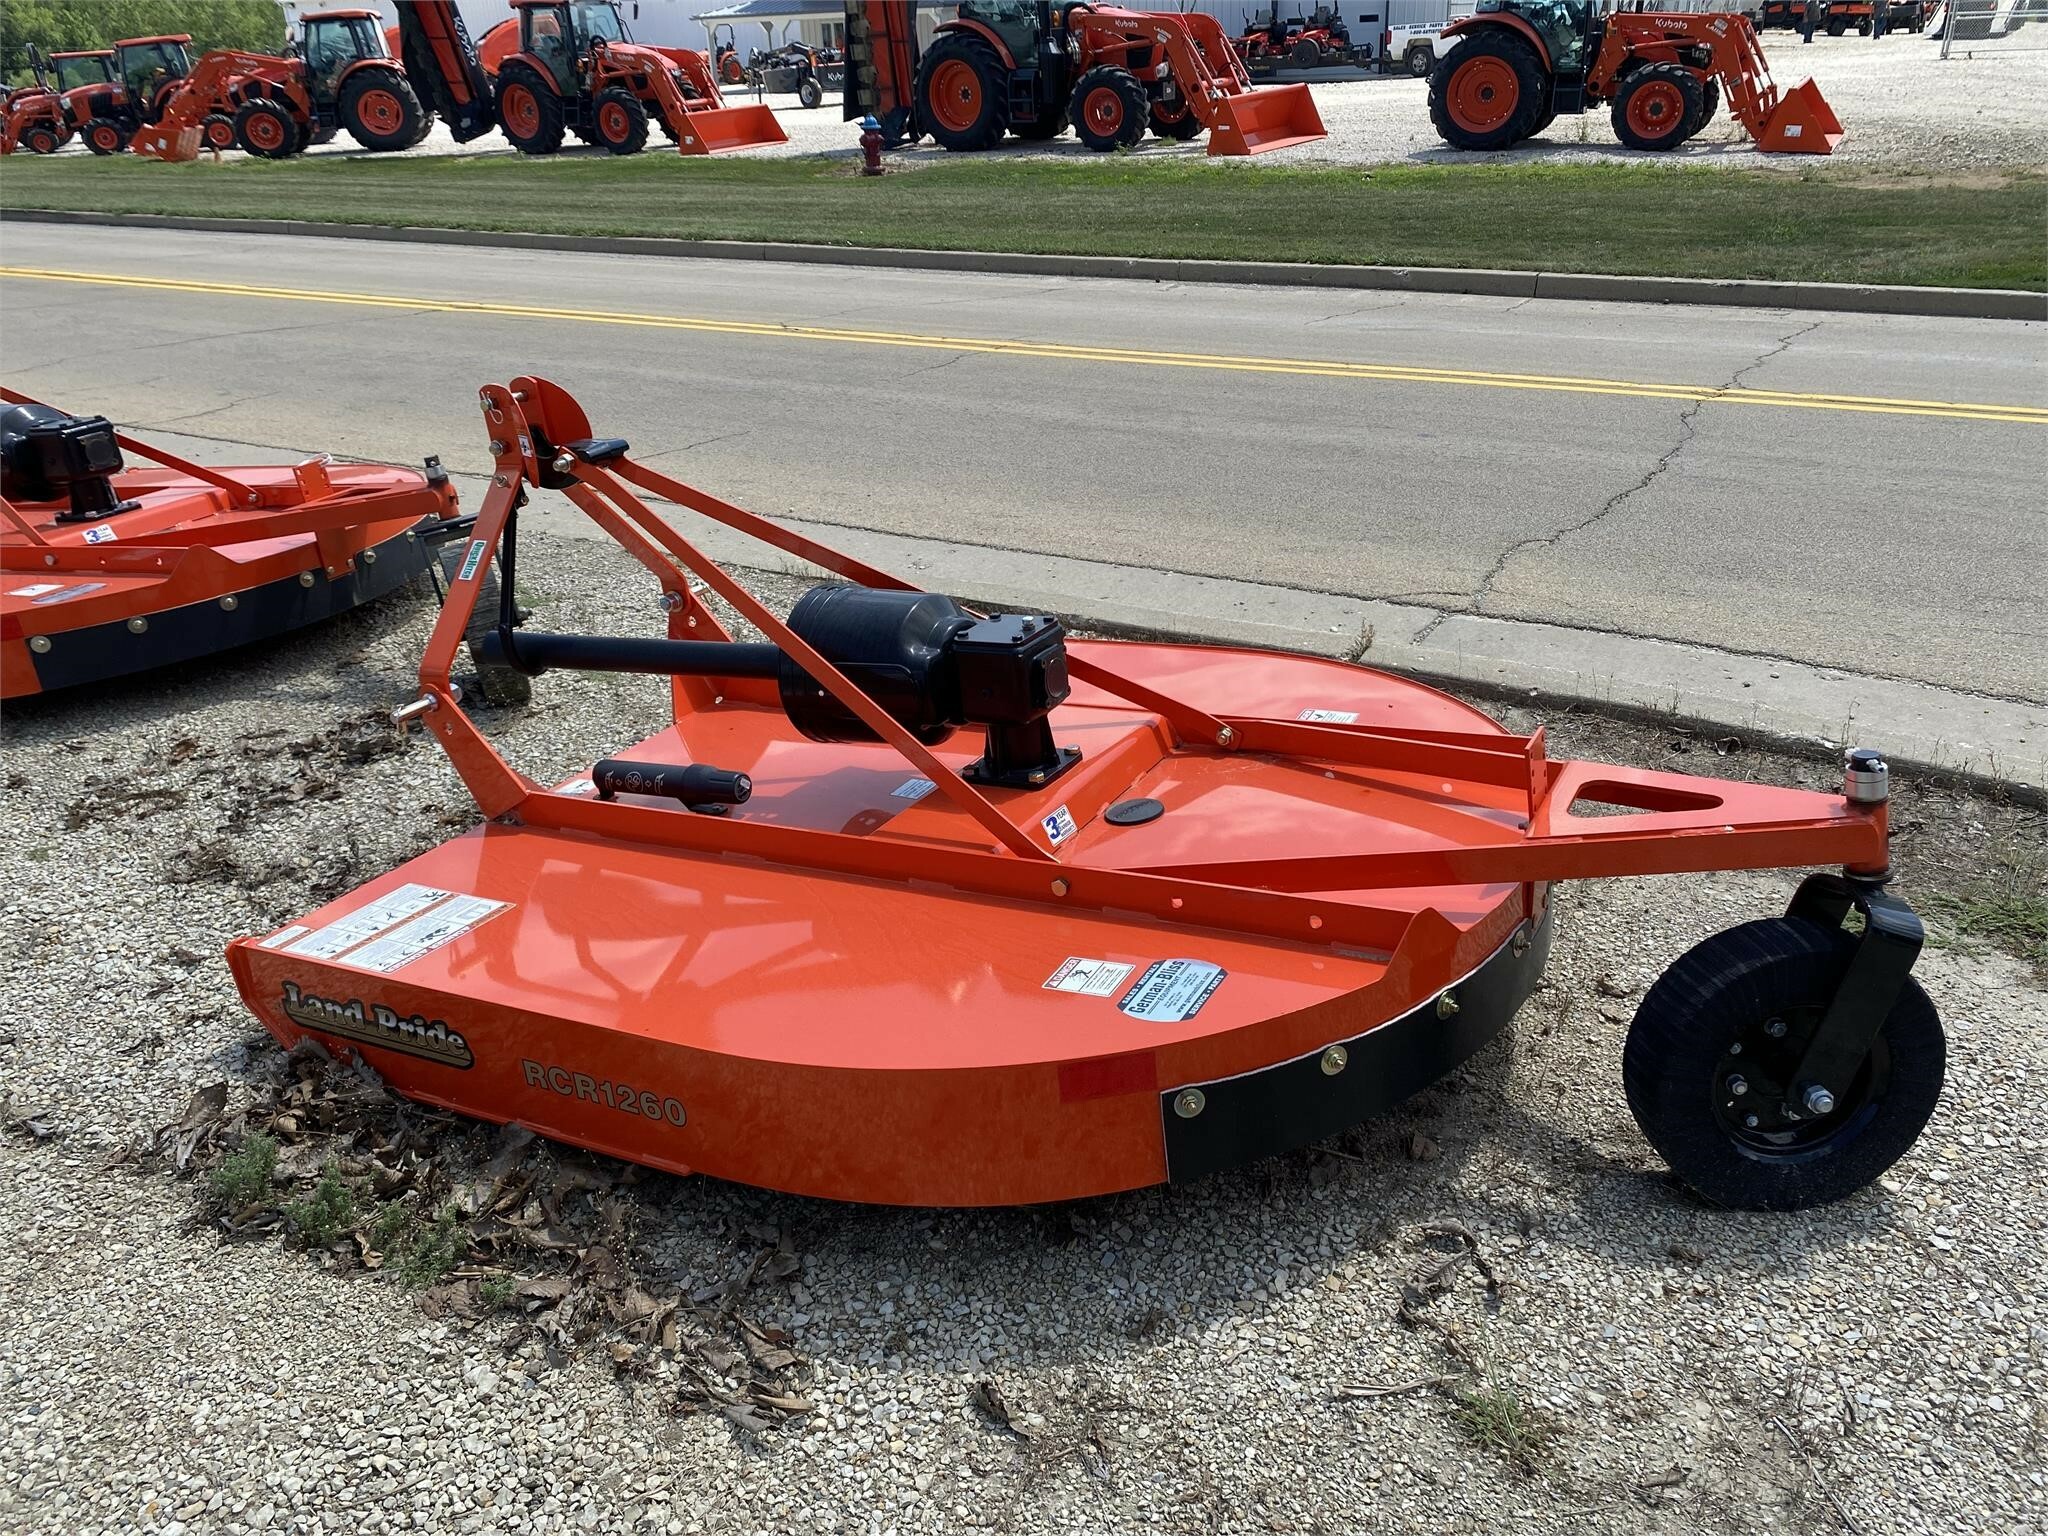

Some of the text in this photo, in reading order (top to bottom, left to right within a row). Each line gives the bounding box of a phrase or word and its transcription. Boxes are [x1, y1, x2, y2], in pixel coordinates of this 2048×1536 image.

[1115, 20, 1138, 28] Kubota
[1655, 18, 1688, 30] Kubota
[86, 529, 100, 543] 3
[1045, 816, 1061, 840] 3
[1053, 959, 1080, 983] DANGER
[1128, 960, 1185, 1014] German-Bliss
[1157, 975, 1181, 1001] EQUIPMENT
[1189, 992, 1209, 1015] SERVICE
[1210, 975, 1225, 990] PARTS
[284, 983, 466, 1057] Land Pride
[522, 1058, 688, 1128] RCR1260
